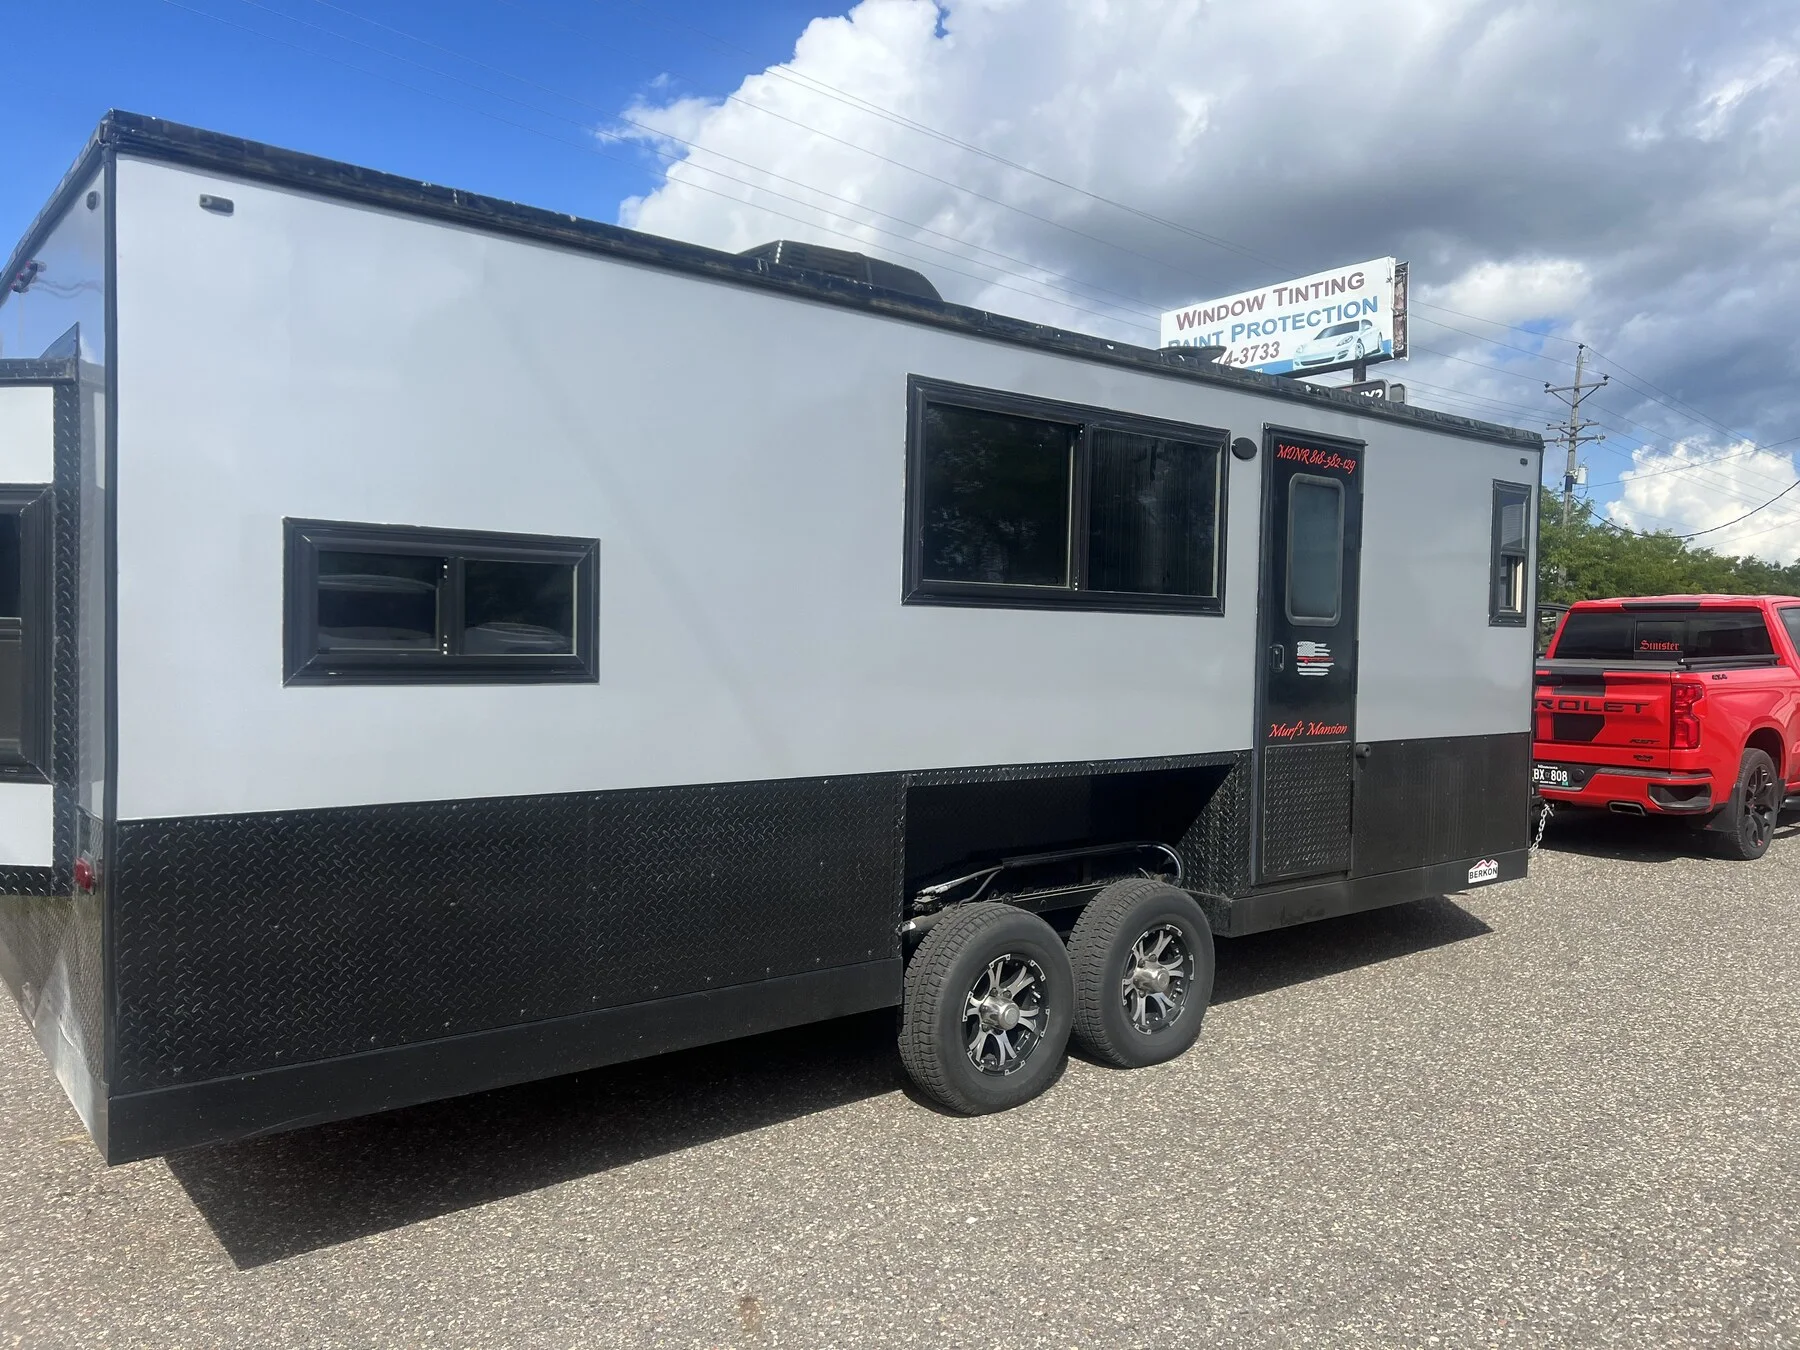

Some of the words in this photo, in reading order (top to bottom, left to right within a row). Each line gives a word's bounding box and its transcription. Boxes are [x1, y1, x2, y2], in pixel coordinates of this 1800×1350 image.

[1176, 293, 1267, 331] WINDOW
[1273, 271, 1365, 307] TINTING
[1231, 295, 1378, 342] PROTECTION
[1217, 340, 1281, 367] 4-3733
[1277, 443, 1310, 465] MDNR
[1640, 639, 1680, 651] Sinister
[1269, 720, 1305, 741] Murf's
[1306, 720, 1348, 736] Mansion
[1550, 769, 1568, 782] 808
[1469, 867, 1498, 880] BERKON
